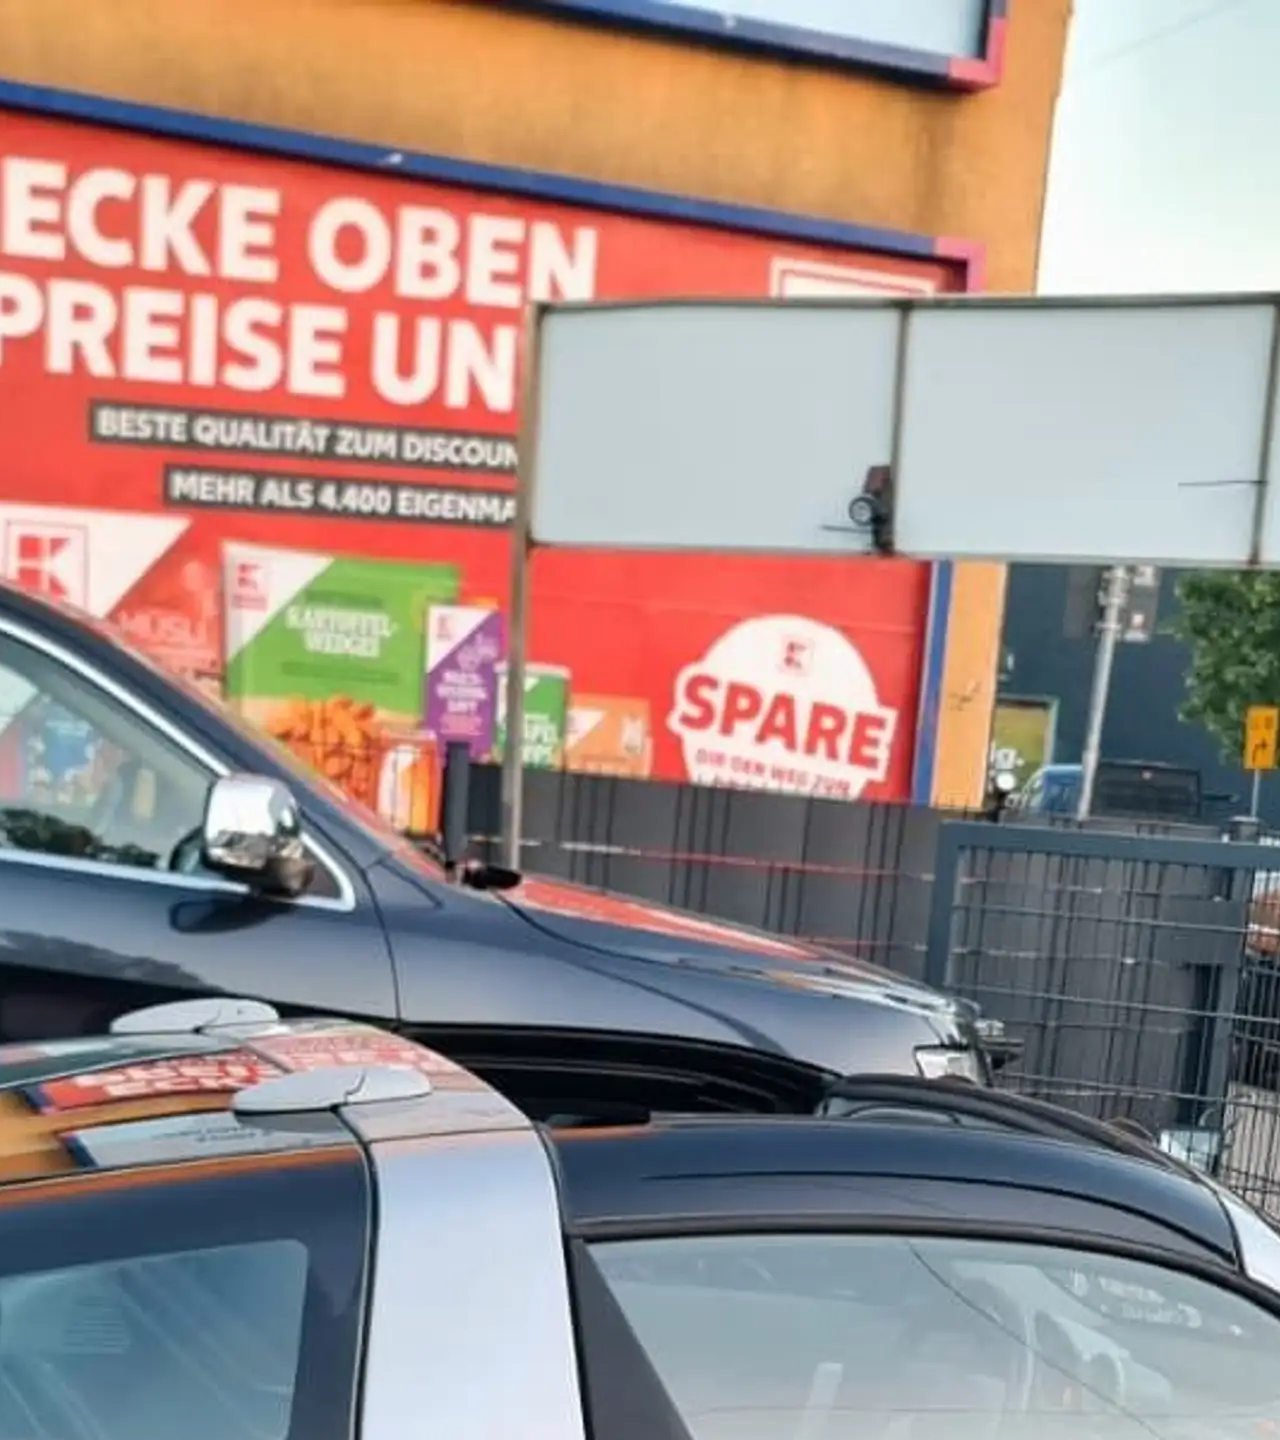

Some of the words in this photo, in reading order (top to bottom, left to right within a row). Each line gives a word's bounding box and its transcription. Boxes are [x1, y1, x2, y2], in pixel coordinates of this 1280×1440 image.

[0, 157, 280, 283] ECKE
[308, 197, 598, 308] OBEN
[95, 406, 188, 443] BESTE
[192, 418, 331, 454] QUALITÄT
[335, 430, 397, 460] ZUM
[170, 471, 255, 504] MEHR
[260, 476, 313, 509] ALS
[318, 482, 390, 515] 4.400
[678, 673, 888, 771] SPARE
